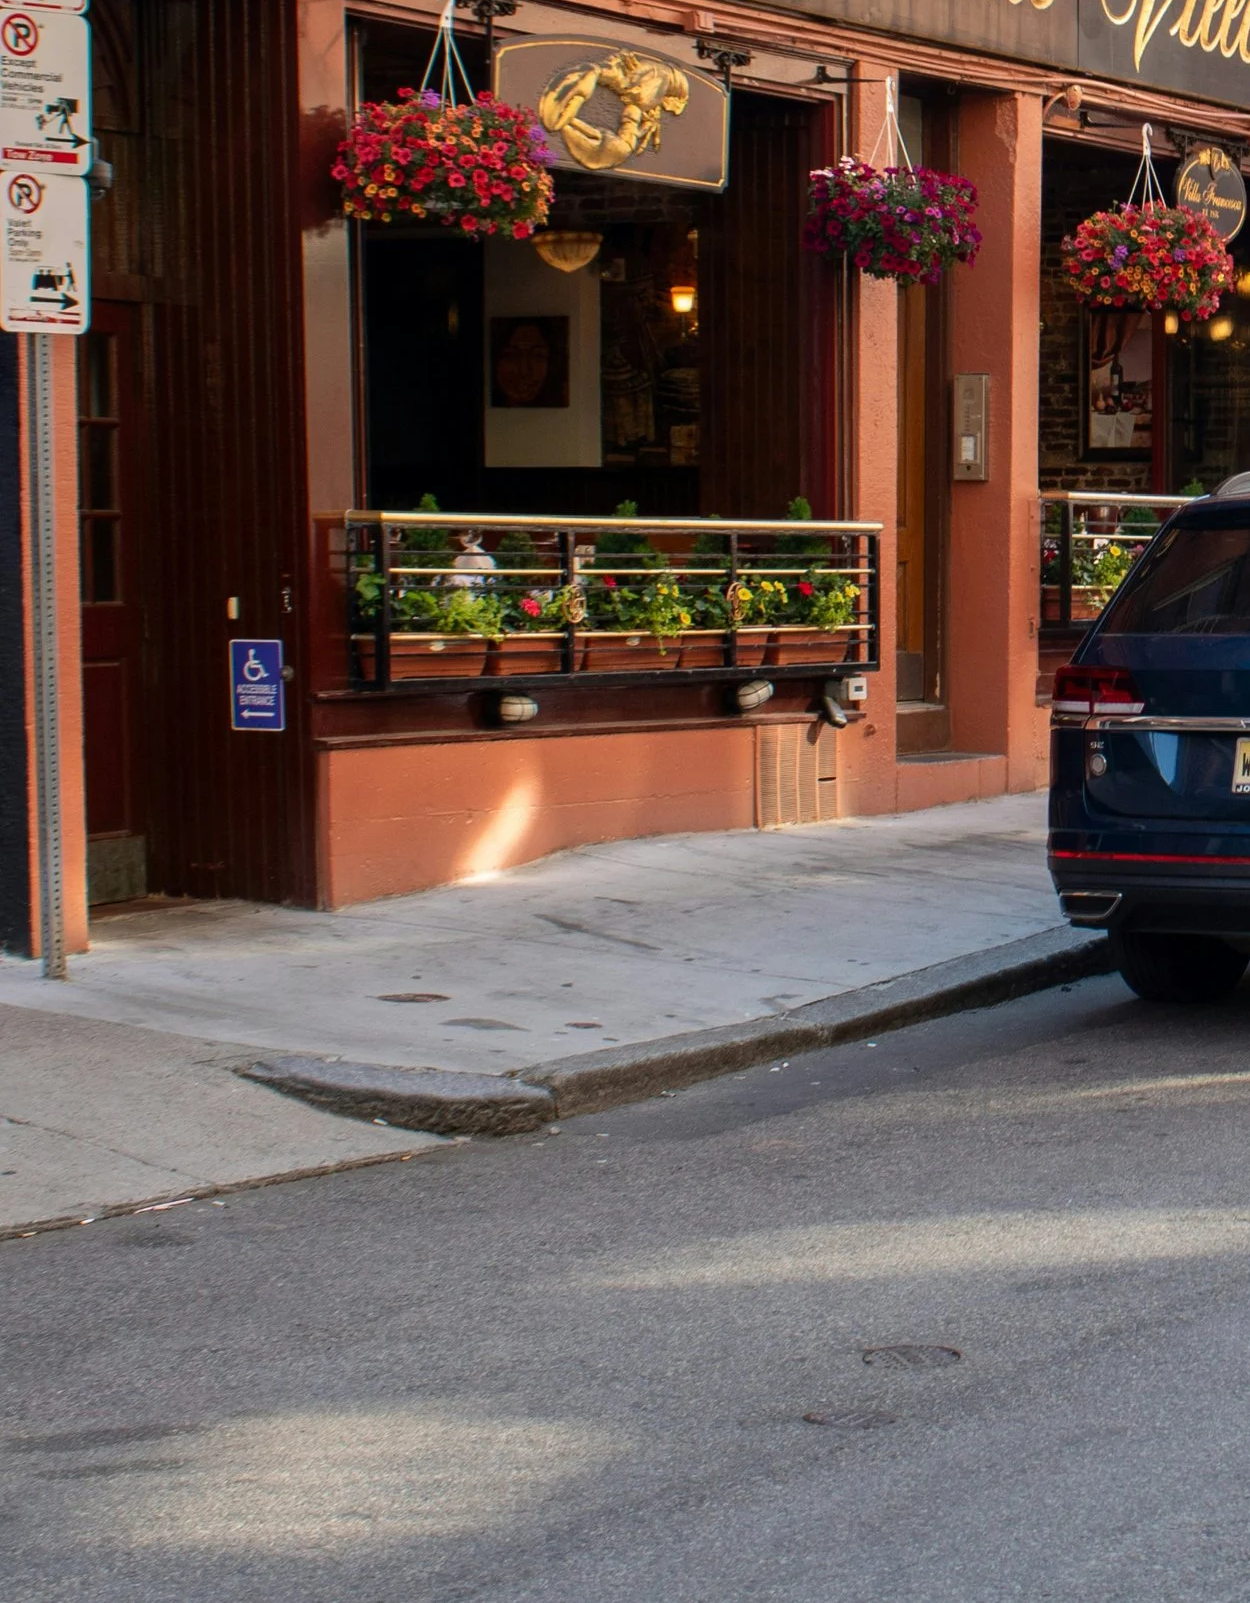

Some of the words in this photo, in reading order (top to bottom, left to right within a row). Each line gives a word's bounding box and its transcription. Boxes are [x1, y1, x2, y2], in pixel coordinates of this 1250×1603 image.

[1, 55, 37, 69] Except
[1, 68, 63, 83] Commercial
[1, 80, 45, 94] Vehicles
[7, 228, 43, 240] Parking
[236, 684, 278, 695] ACCESSIBLE
[239, 695, 276, 706] ENTRANCE
